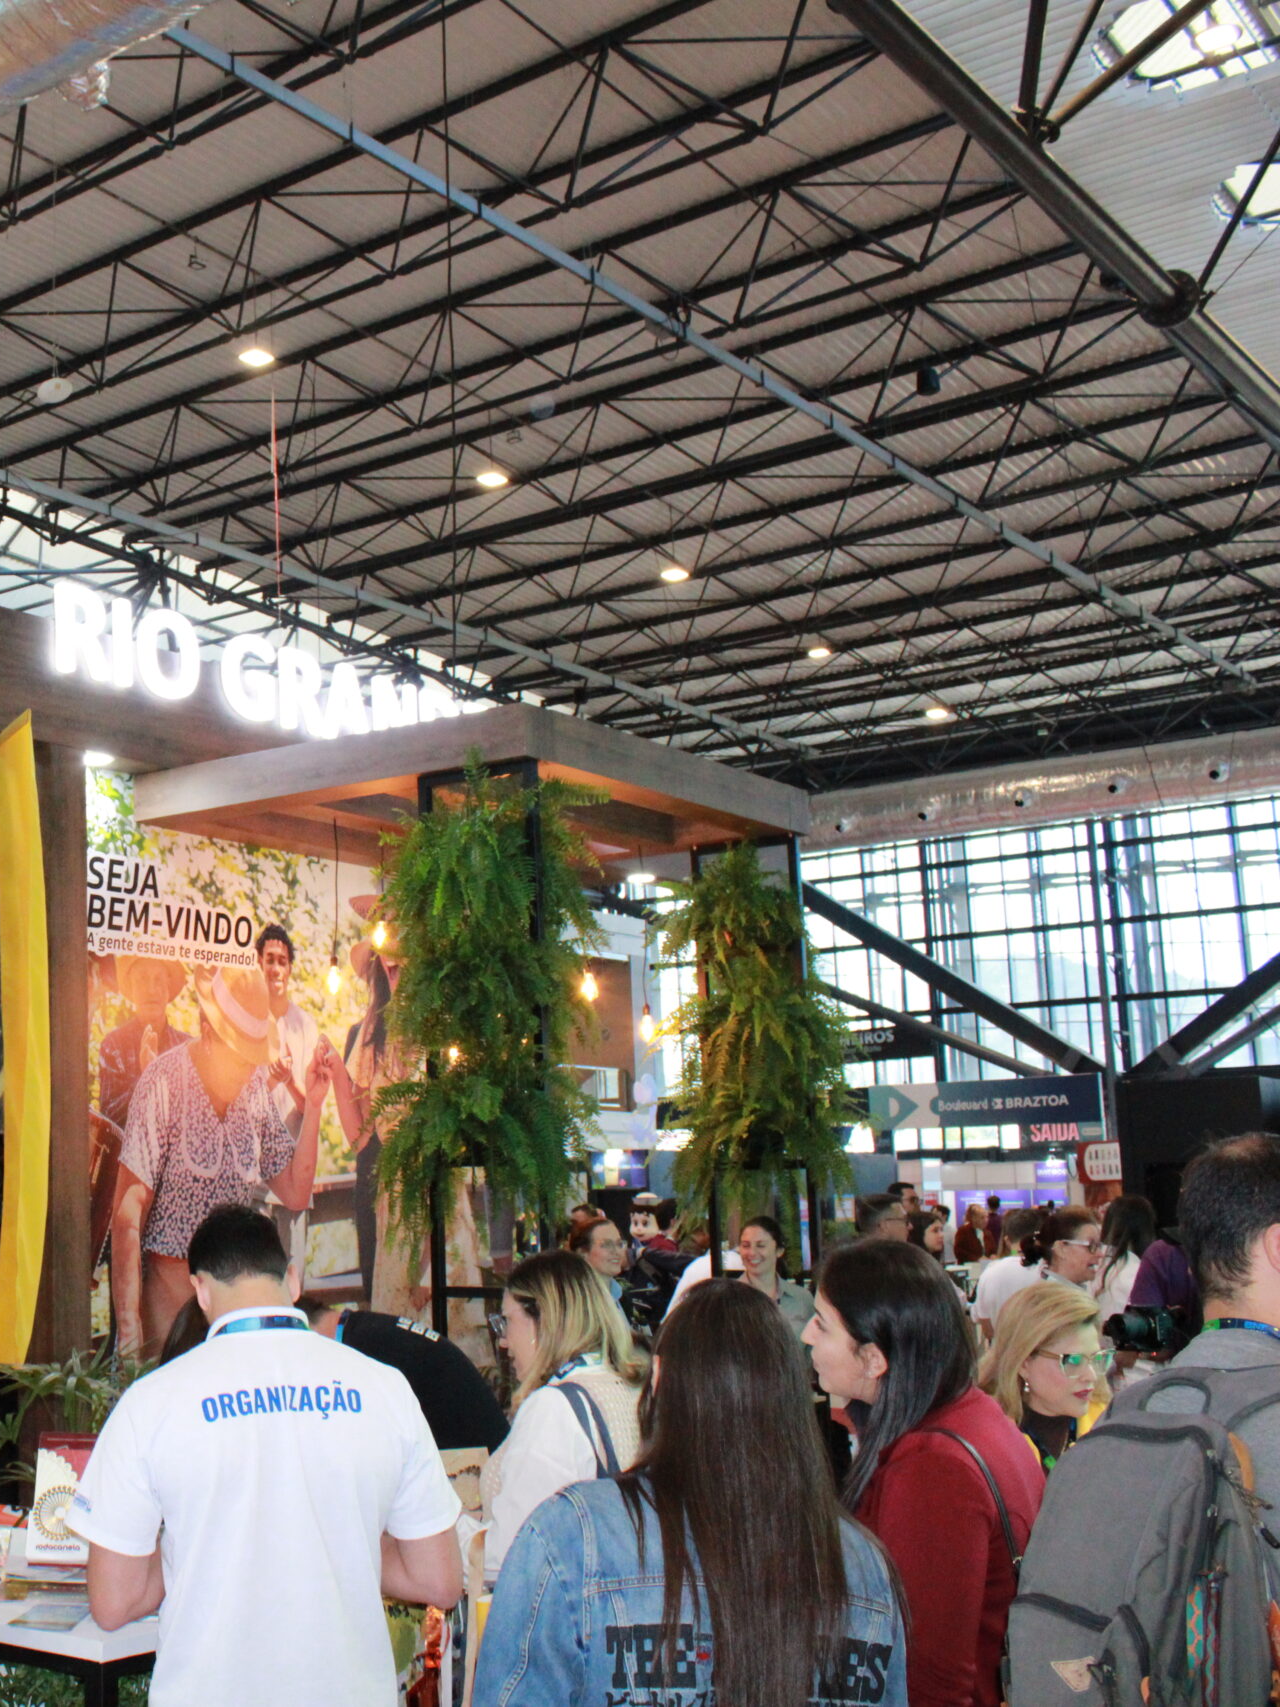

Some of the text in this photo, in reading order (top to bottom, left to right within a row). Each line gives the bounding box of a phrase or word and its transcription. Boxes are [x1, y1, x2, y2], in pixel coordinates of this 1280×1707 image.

[53, 580, 200, 699] RIO
[87, 856, 159, 898] SEJA
[87, 894, 252, 947] BEM-VINDO
[87, 932, 255, 966] A gente estava te esperando!
[1005, 1094, 1069, 1109] BRAZTOA
[201, 1380, 362, 1422] ORGANIZAÇÃO
